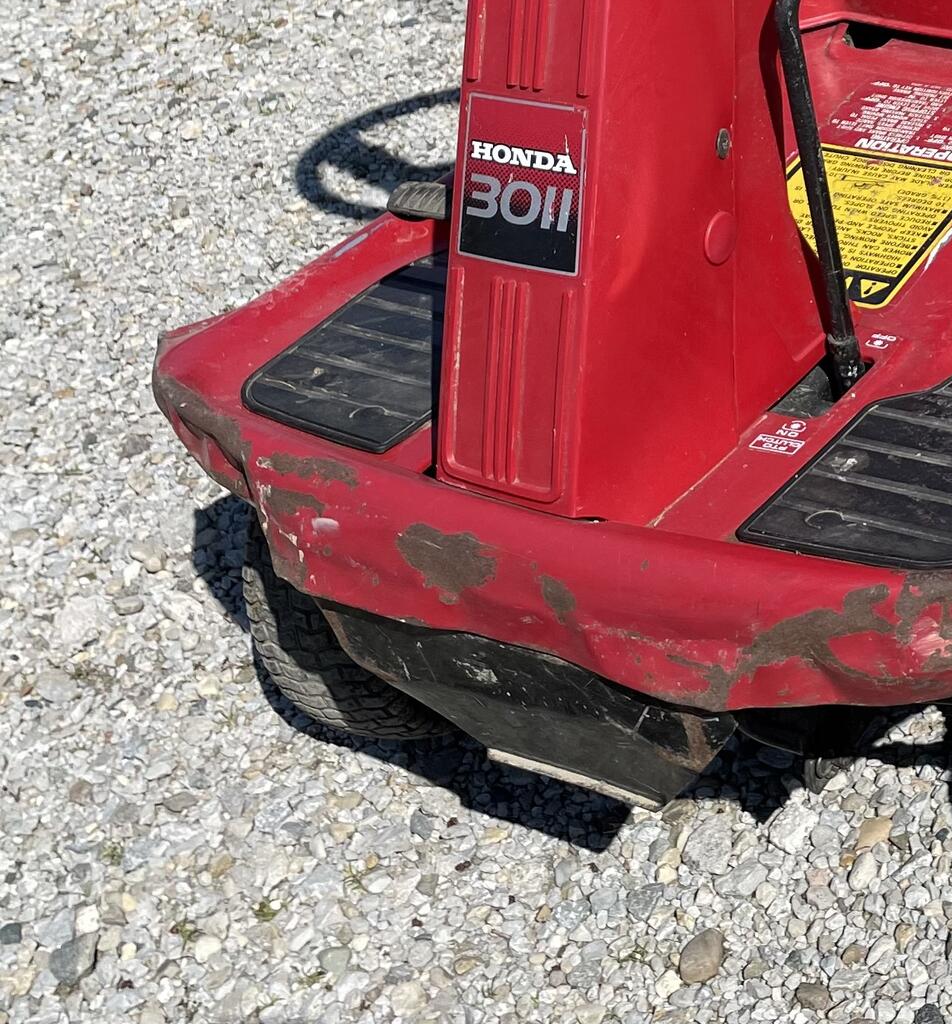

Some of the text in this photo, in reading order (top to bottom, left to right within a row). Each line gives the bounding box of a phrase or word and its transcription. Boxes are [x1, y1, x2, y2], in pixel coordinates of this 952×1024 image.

[471, 140, 577, 175] HONDA
[466, 173, 573, 232] 3011
[892, 208, 936, 218] OPERATING
[902, 204, 941, 213] MAXIMUM
[900, 216, 931, 224] REDUCE
[867, 224, 897, 232] PEOPLE
[880, 240, 911, 249] BEFORE
[859, 251, 900, 261] HIGHWAYS
[850, 256, 895, 267] OPERATION
[855, 264, 897, 275] OPERATOR
[871, 333, 896, 342] OFF
[776, 429, 799, 438] ON
[758, 436, 801, 448] CLUTCH
[762, 443, 788, 451] PTO
